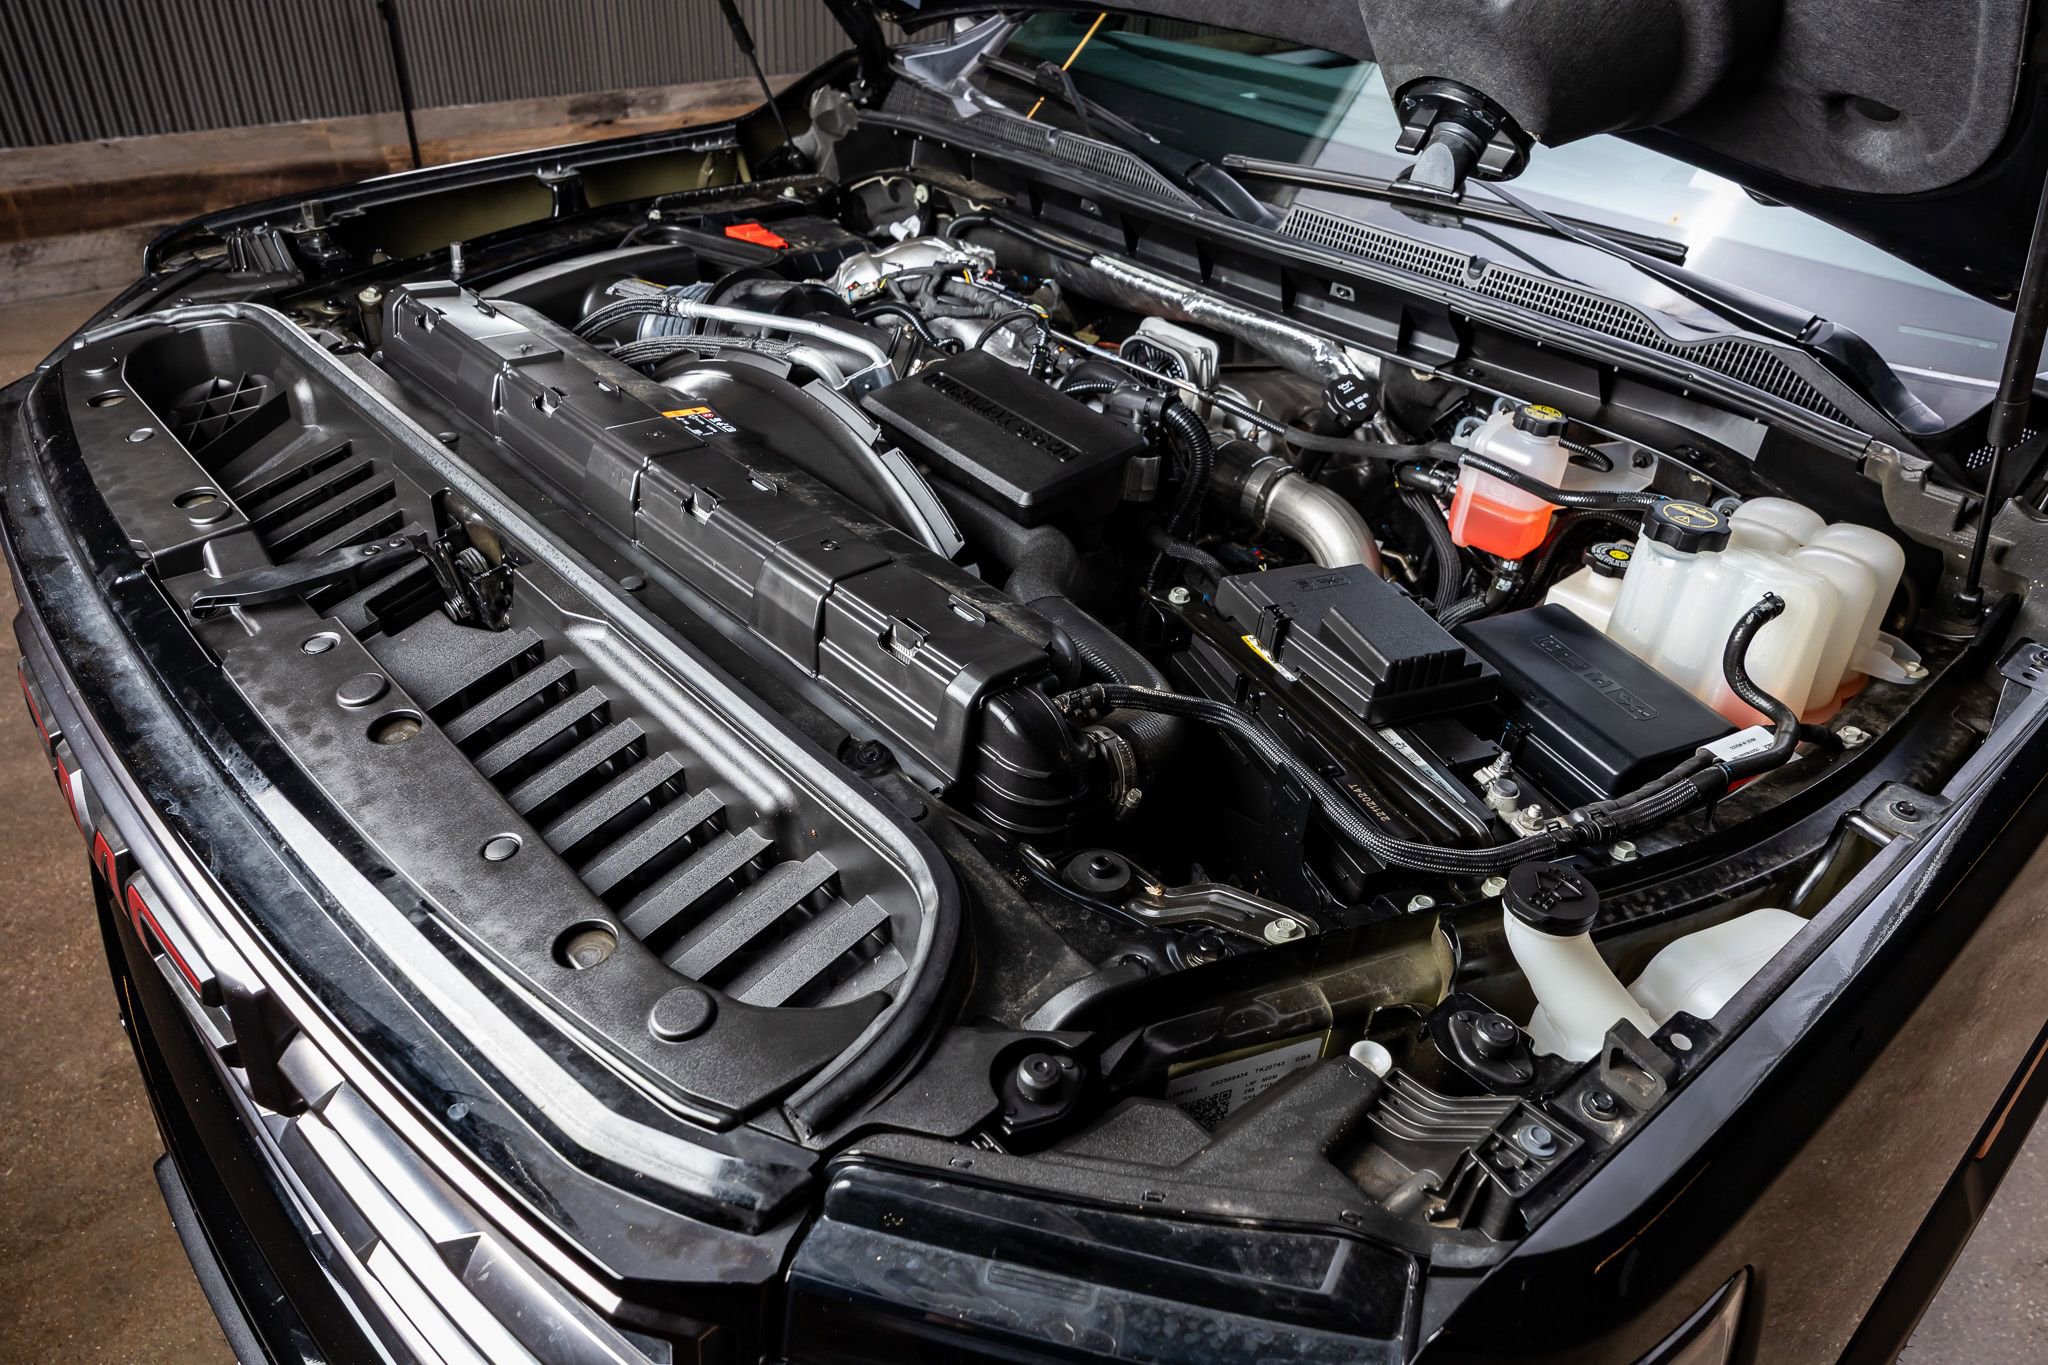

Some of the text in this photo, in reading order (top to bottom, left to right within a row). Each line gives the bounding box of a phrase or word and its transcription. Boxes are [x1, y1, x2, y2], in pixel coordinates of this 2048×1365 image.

[924, 374, 1014, 427] DURAMAX
[1348, 783, 1391, 823] 22112024T
[1295, 1053, 1311, 1063] GBA
